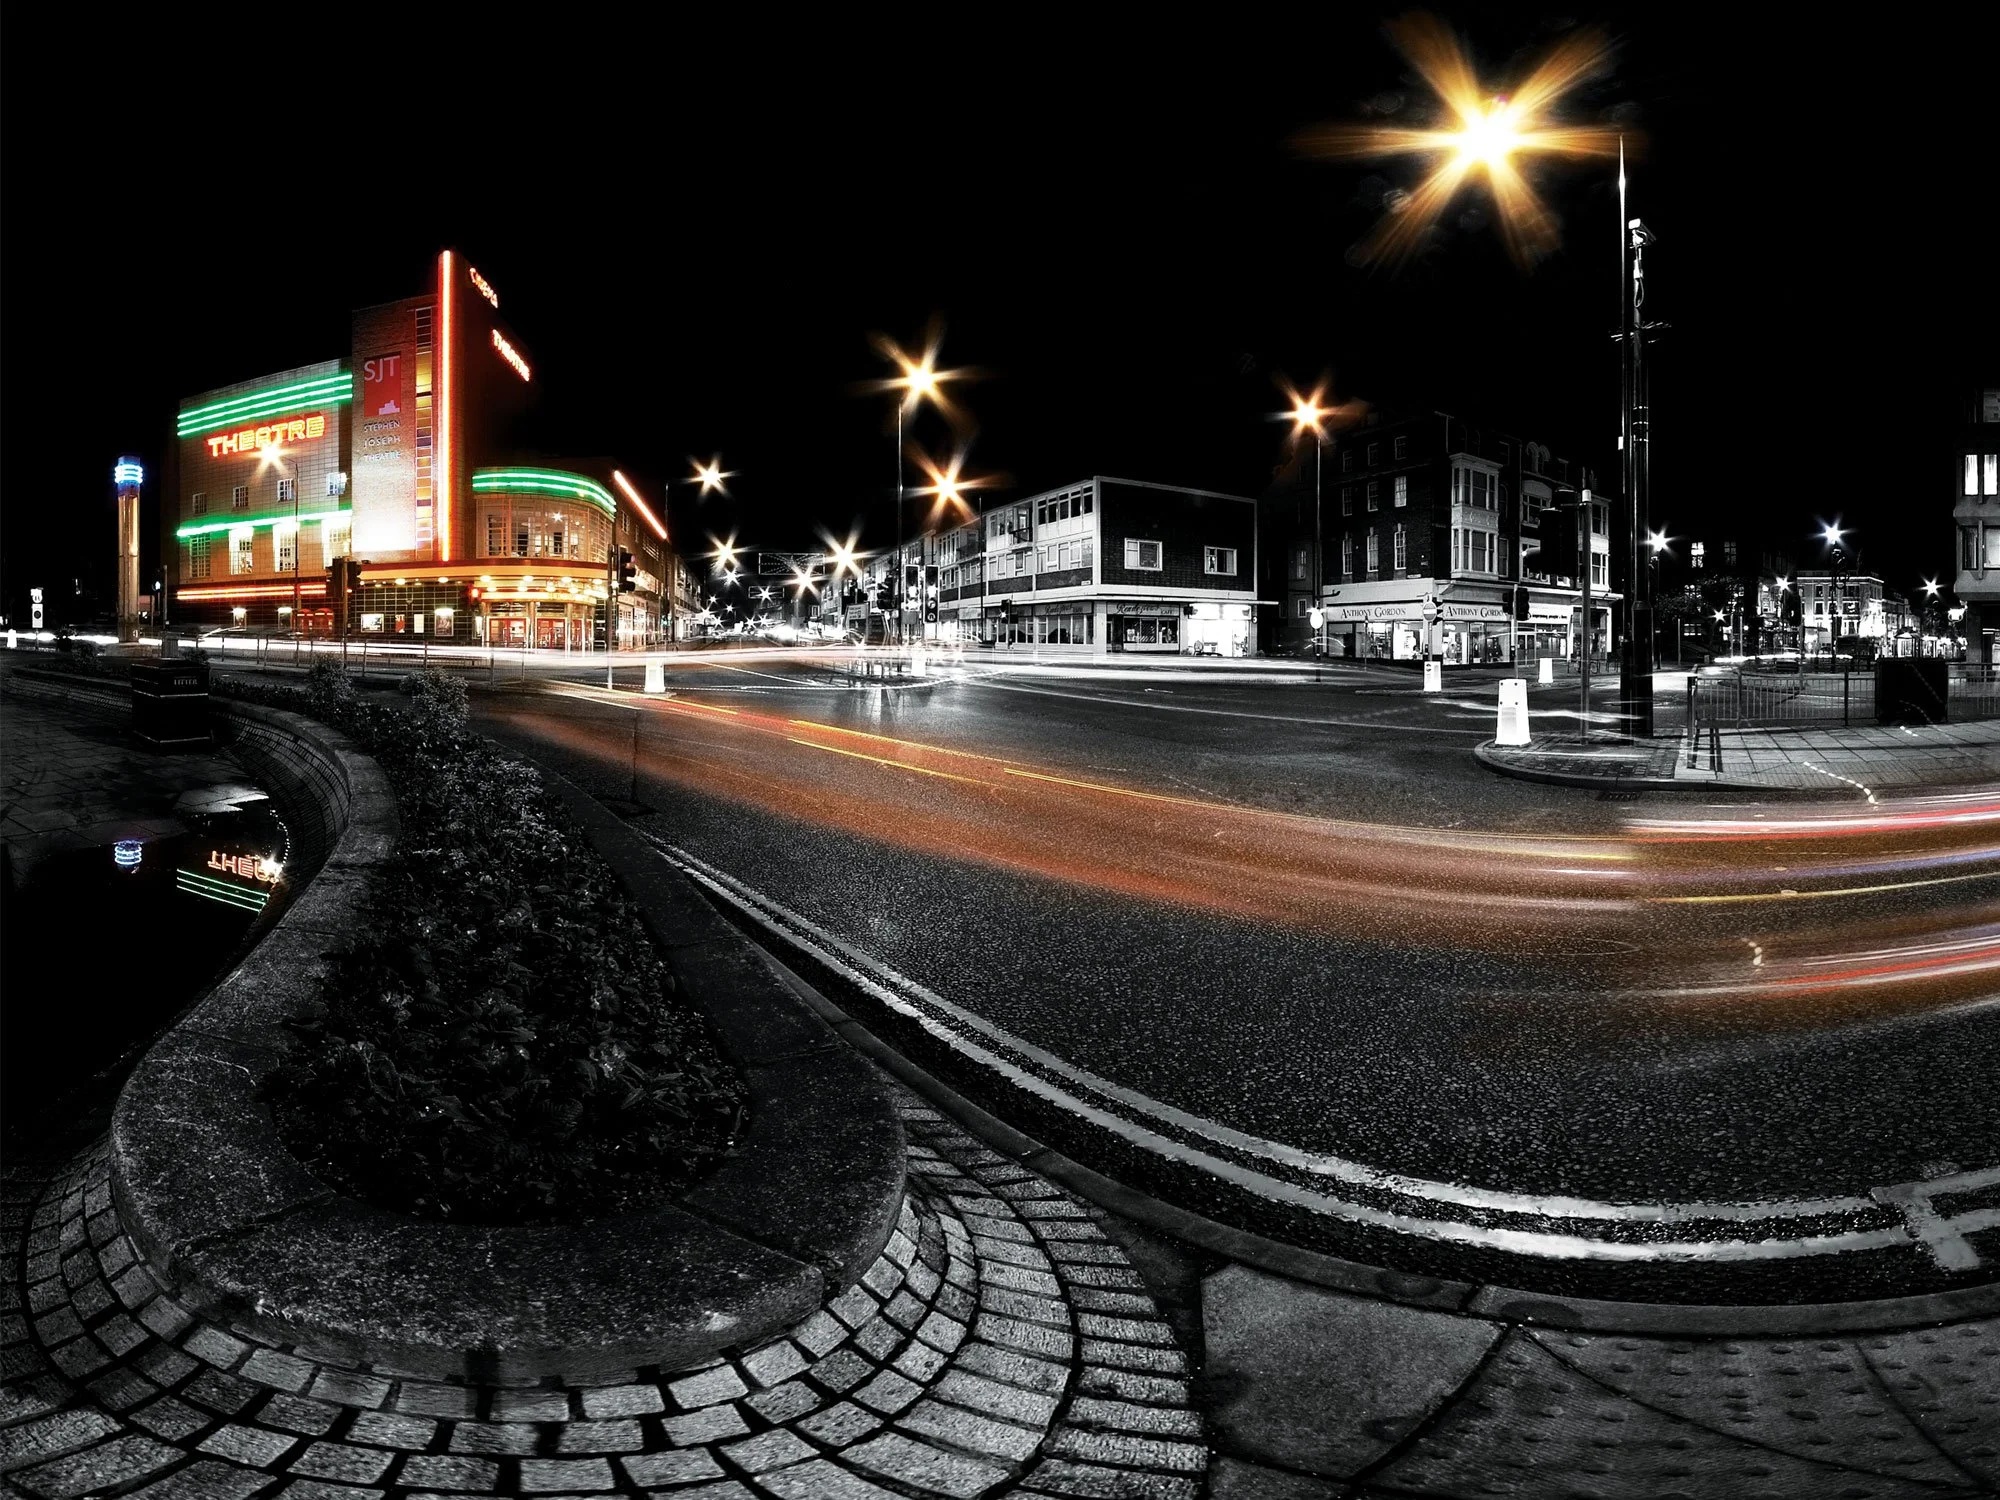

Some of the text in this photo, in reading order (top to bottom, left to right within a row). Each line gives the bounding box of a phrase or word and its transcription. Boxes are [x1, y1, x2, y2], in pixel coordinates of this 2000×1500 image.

[364, 355, 400, 383] SJT
[363, 420, 400, 433] STEPHEN
[207, 415, 325, 457] THEATRE
[363, 435, 401, 449] JOSEPH
[363, 450, 401, 462] THEATRE
[1341, 608, 1372, 619] ANTHONY
[1446, 606, 1504, 618] ANTHONY GORDO
